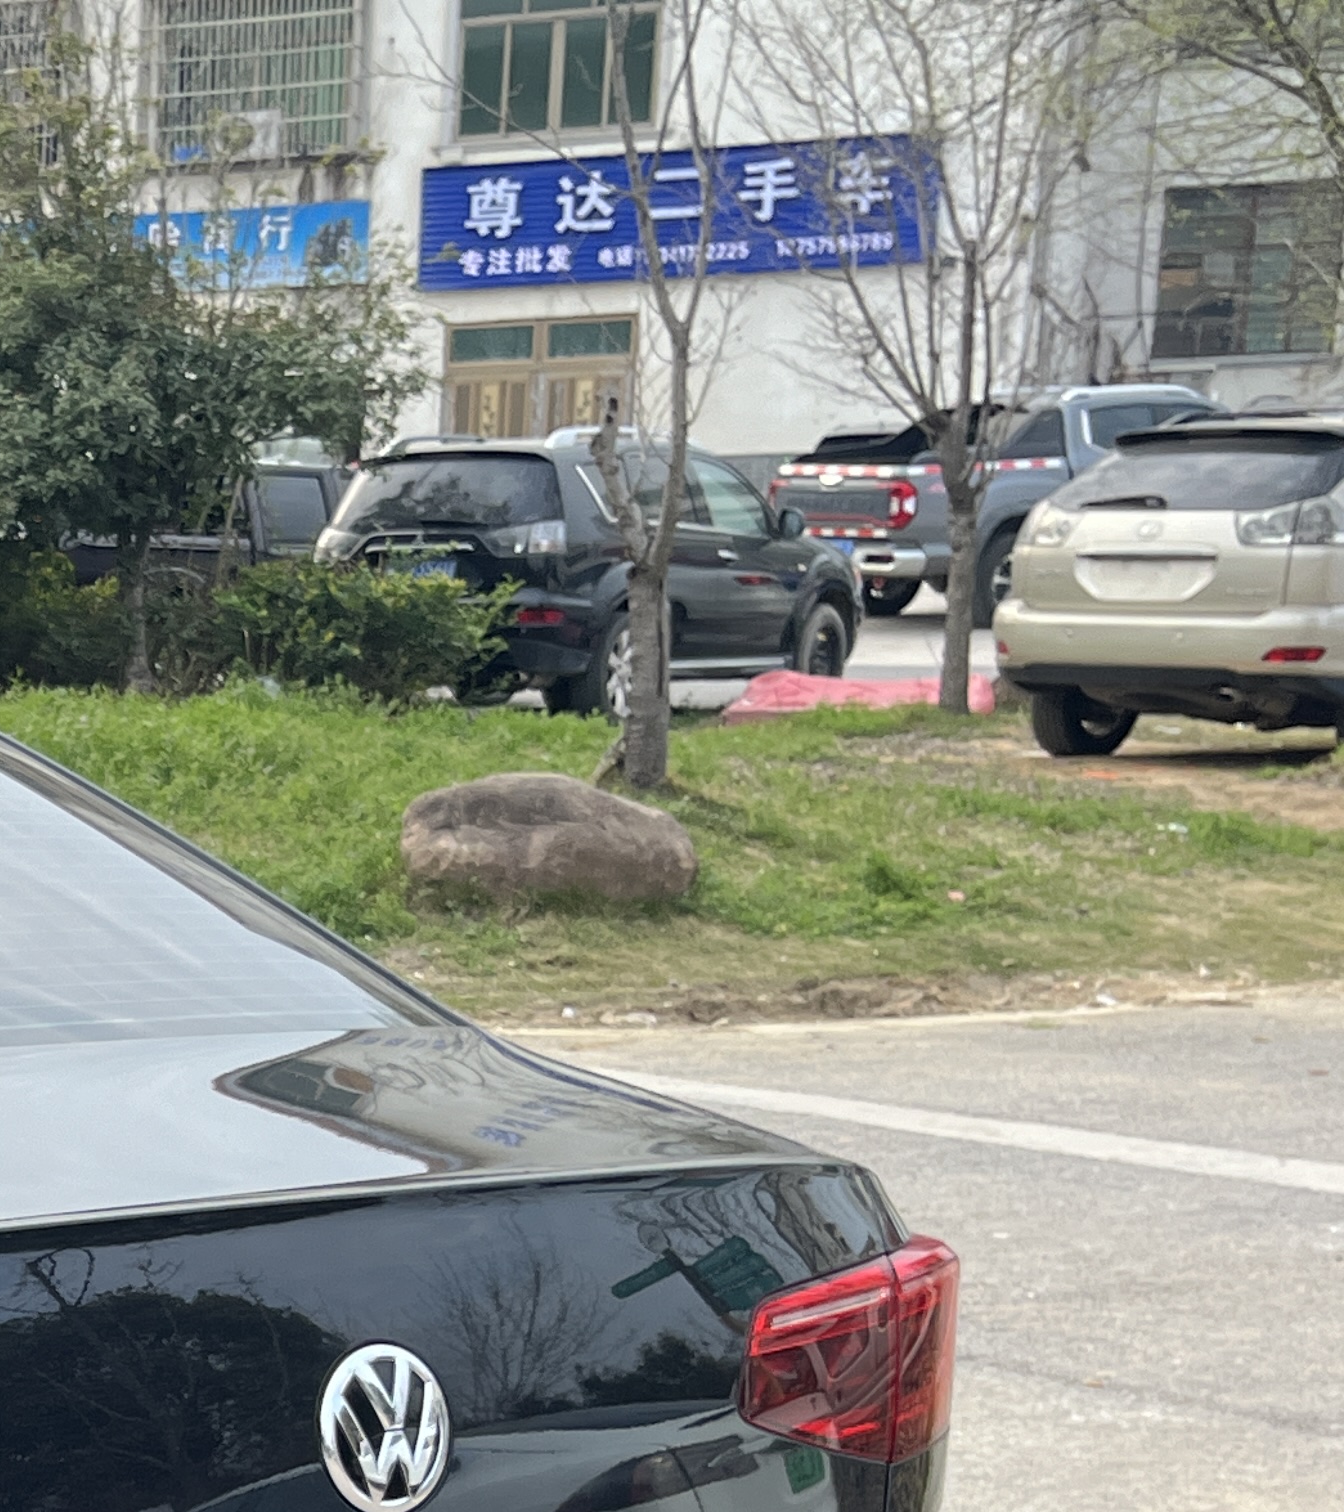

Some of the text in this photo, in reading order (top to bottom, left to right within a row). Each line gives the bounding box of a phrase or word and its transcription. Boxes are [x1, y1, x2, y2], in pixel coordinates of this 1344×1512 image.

[464, 151, 898, 238] 尊达二手车
[458, 243, 572, 277] 专注批发
